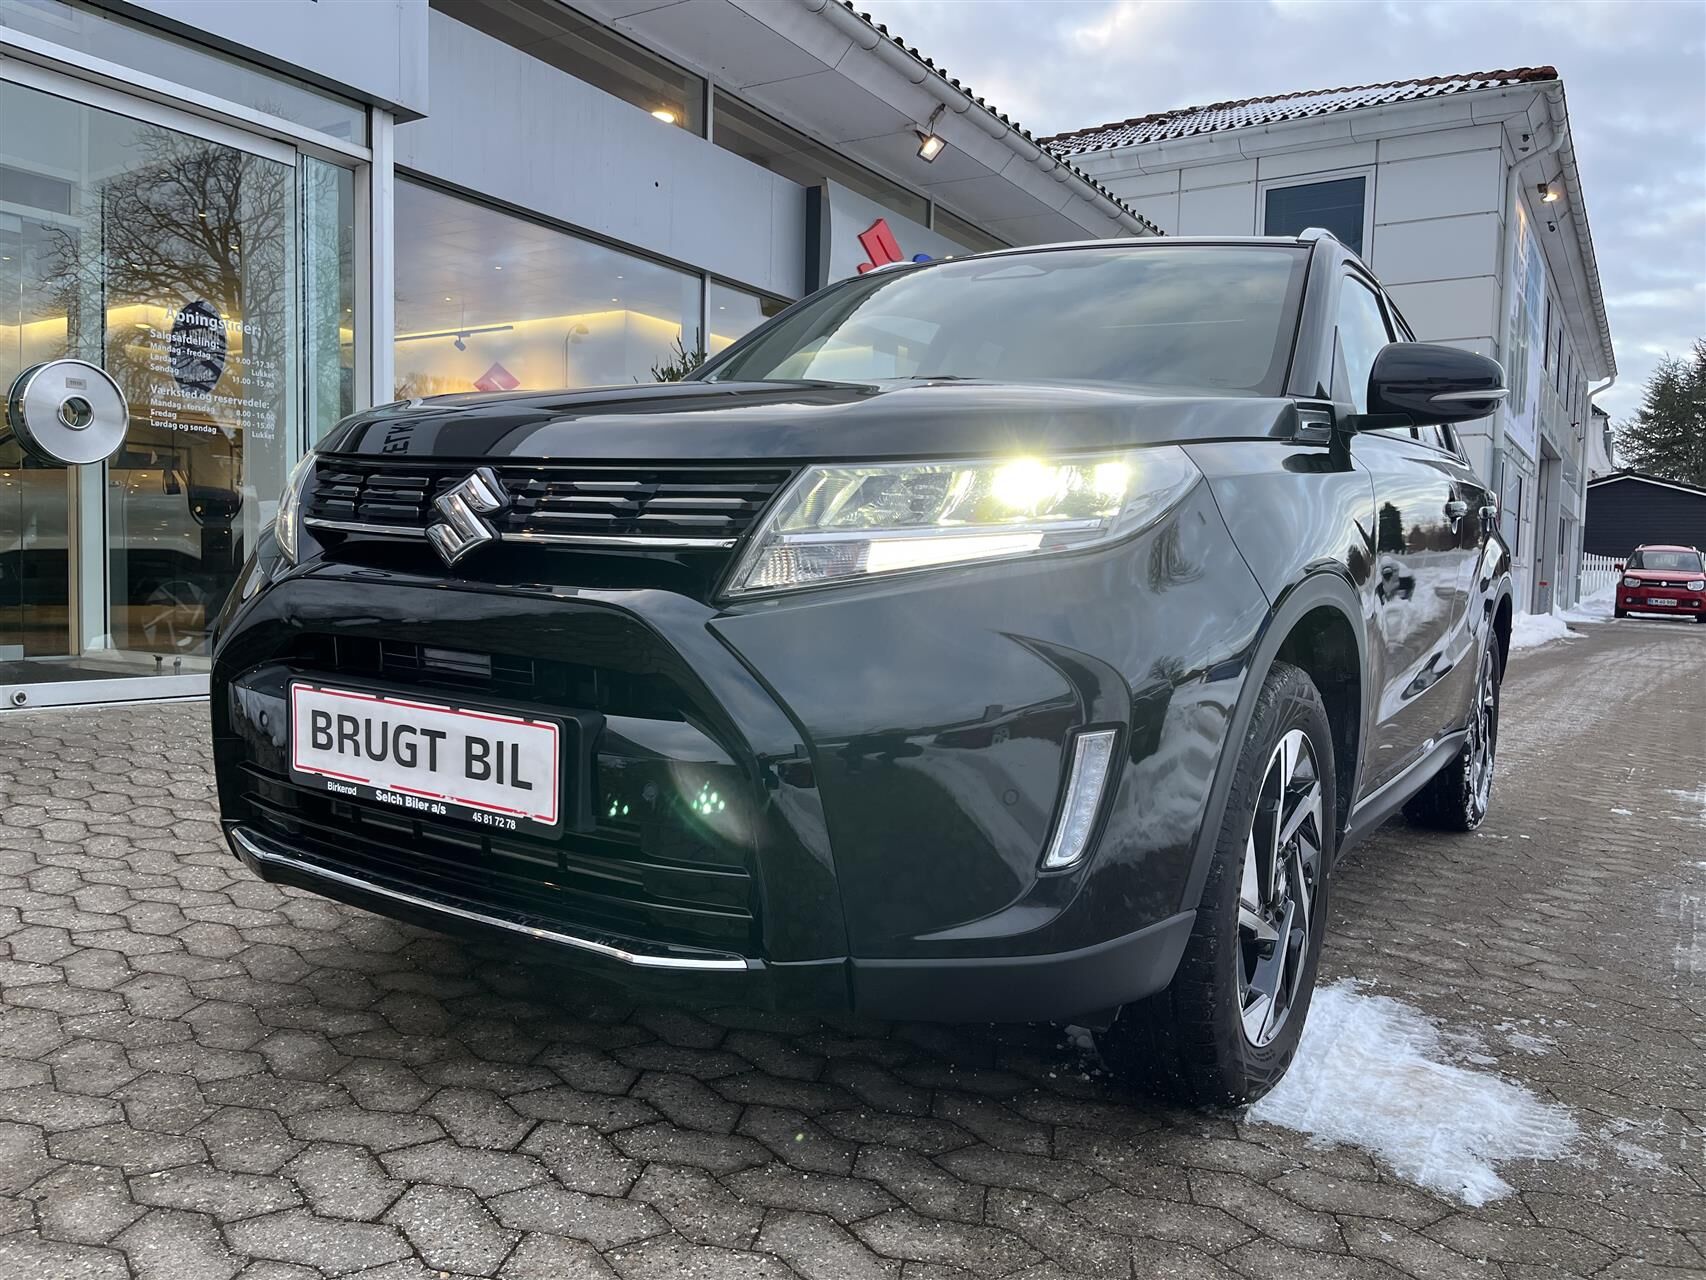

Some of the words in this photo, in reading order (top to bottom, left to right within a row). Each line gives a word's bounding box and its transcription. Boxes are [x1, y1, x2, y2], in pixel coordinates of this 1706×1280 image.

[150, 329, 220, 350] Salgsafdeling:
[186, 348, 211, 360] fredag
[150, 384, 198, 399] Værksted
[199, 393, 212, 403] og
[214, 395, 270, 409] reservedele:
[178, 423, 189, 432] og
[311, 709, 447, 773] BRUGT
[464, 735, 533, 791] BIL
[375, 789, 403, 806] Selch
[405, 796, 430, 811] Biler
[431, 802, 447, 815] a/s
[472, 811, 483, 823] 45
[483, 814, 493, 825] 81
[494, 816, 505, 828] 72
[505, 818, 516, 830] 78
